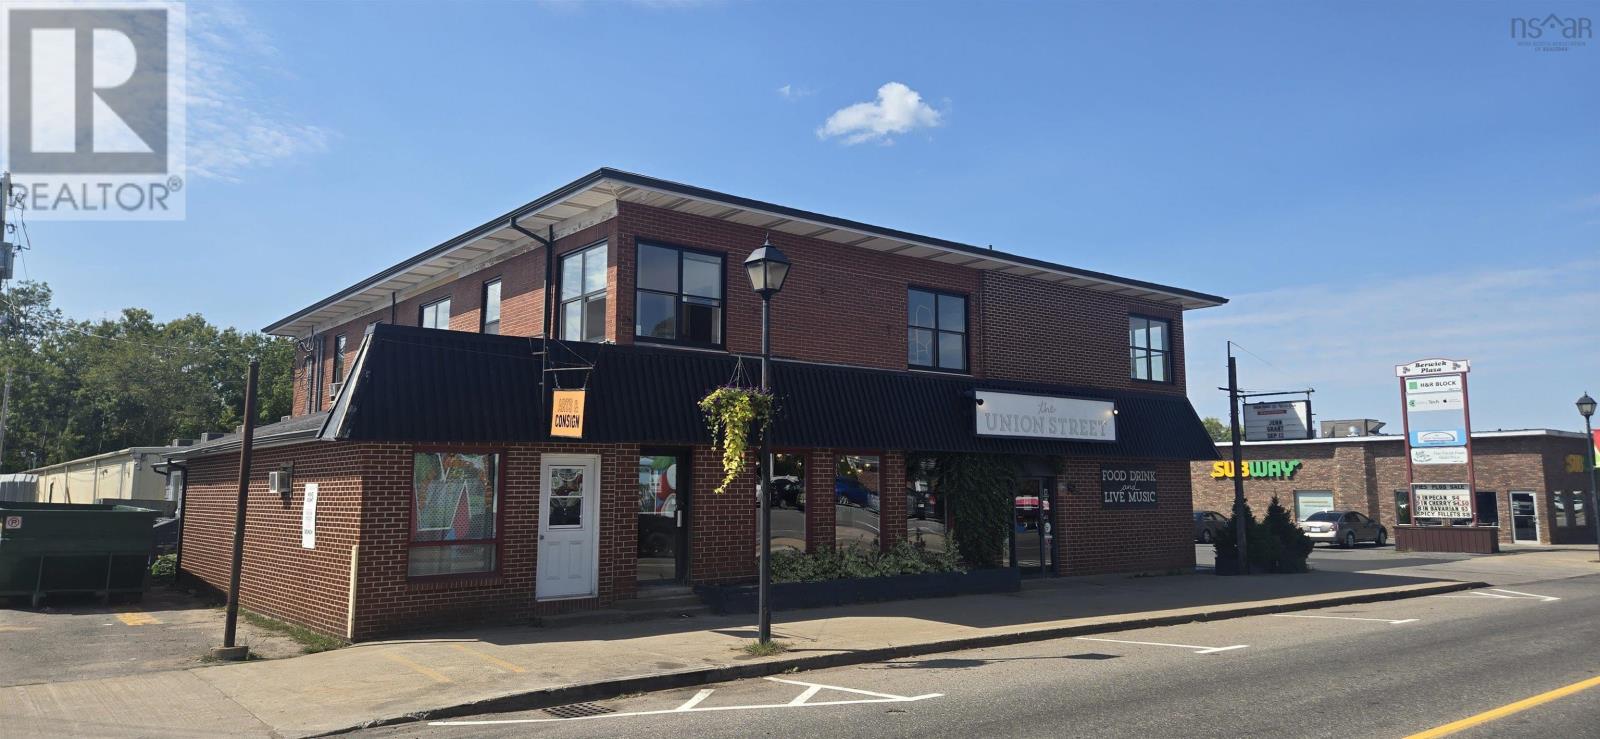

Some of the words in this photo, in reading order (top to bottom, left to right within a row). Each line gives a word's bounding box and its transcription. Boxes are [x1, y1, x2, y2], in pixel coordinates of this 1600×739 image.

[1038, 400, 1056, 414] the
[555, 414, 579, 428] CONSIGN
[985, 413, 1046, 434] UNION
[1049, 417, 1108, 437] STREET
[1102, 470, 1127, 481] FOOD
[1130, 470, 1156, 481] DRINK
[1120, 480, 1140, 491] and
[1104, 491, 1125, 503] LIVE
[1128, 491, 1156, 503] MUSIC
